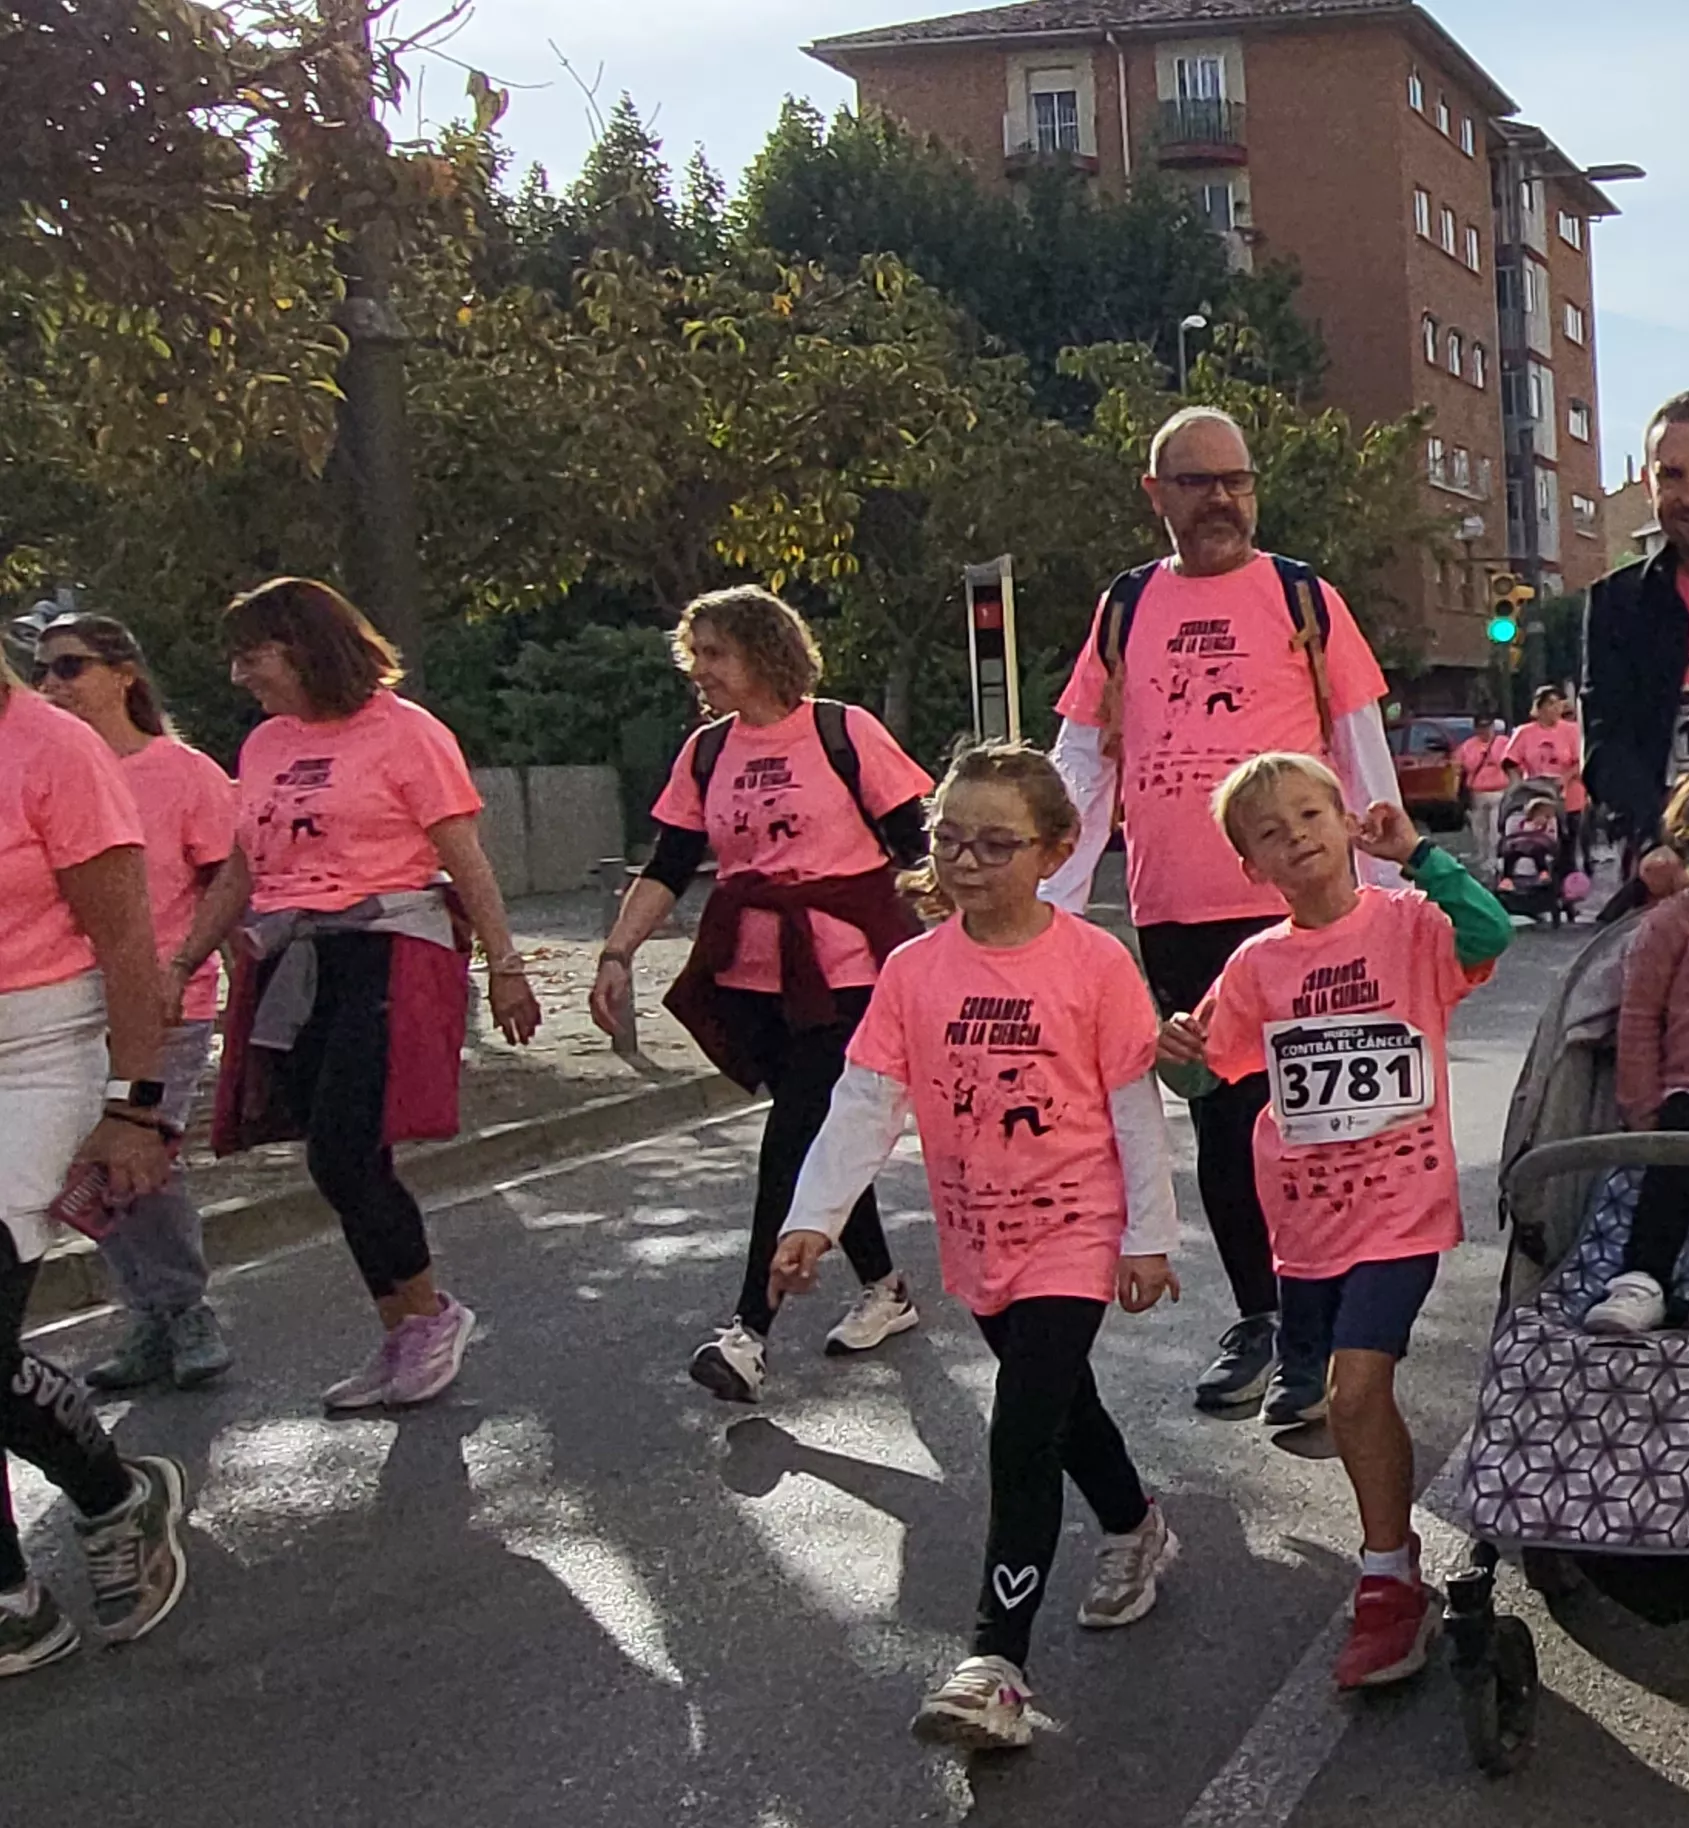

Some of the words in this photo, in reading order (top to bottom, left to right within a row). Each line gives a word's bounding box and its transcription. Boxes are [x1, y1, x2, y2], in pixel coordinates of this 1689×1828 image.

[1281, 1040, 1335, 1057] CONTRA
[1336, 1039, 1354, 1051] EL
[1356, 1033, 1413, 1049] CÁNCER
[1283, 1054, 1413, 1109] 3781
